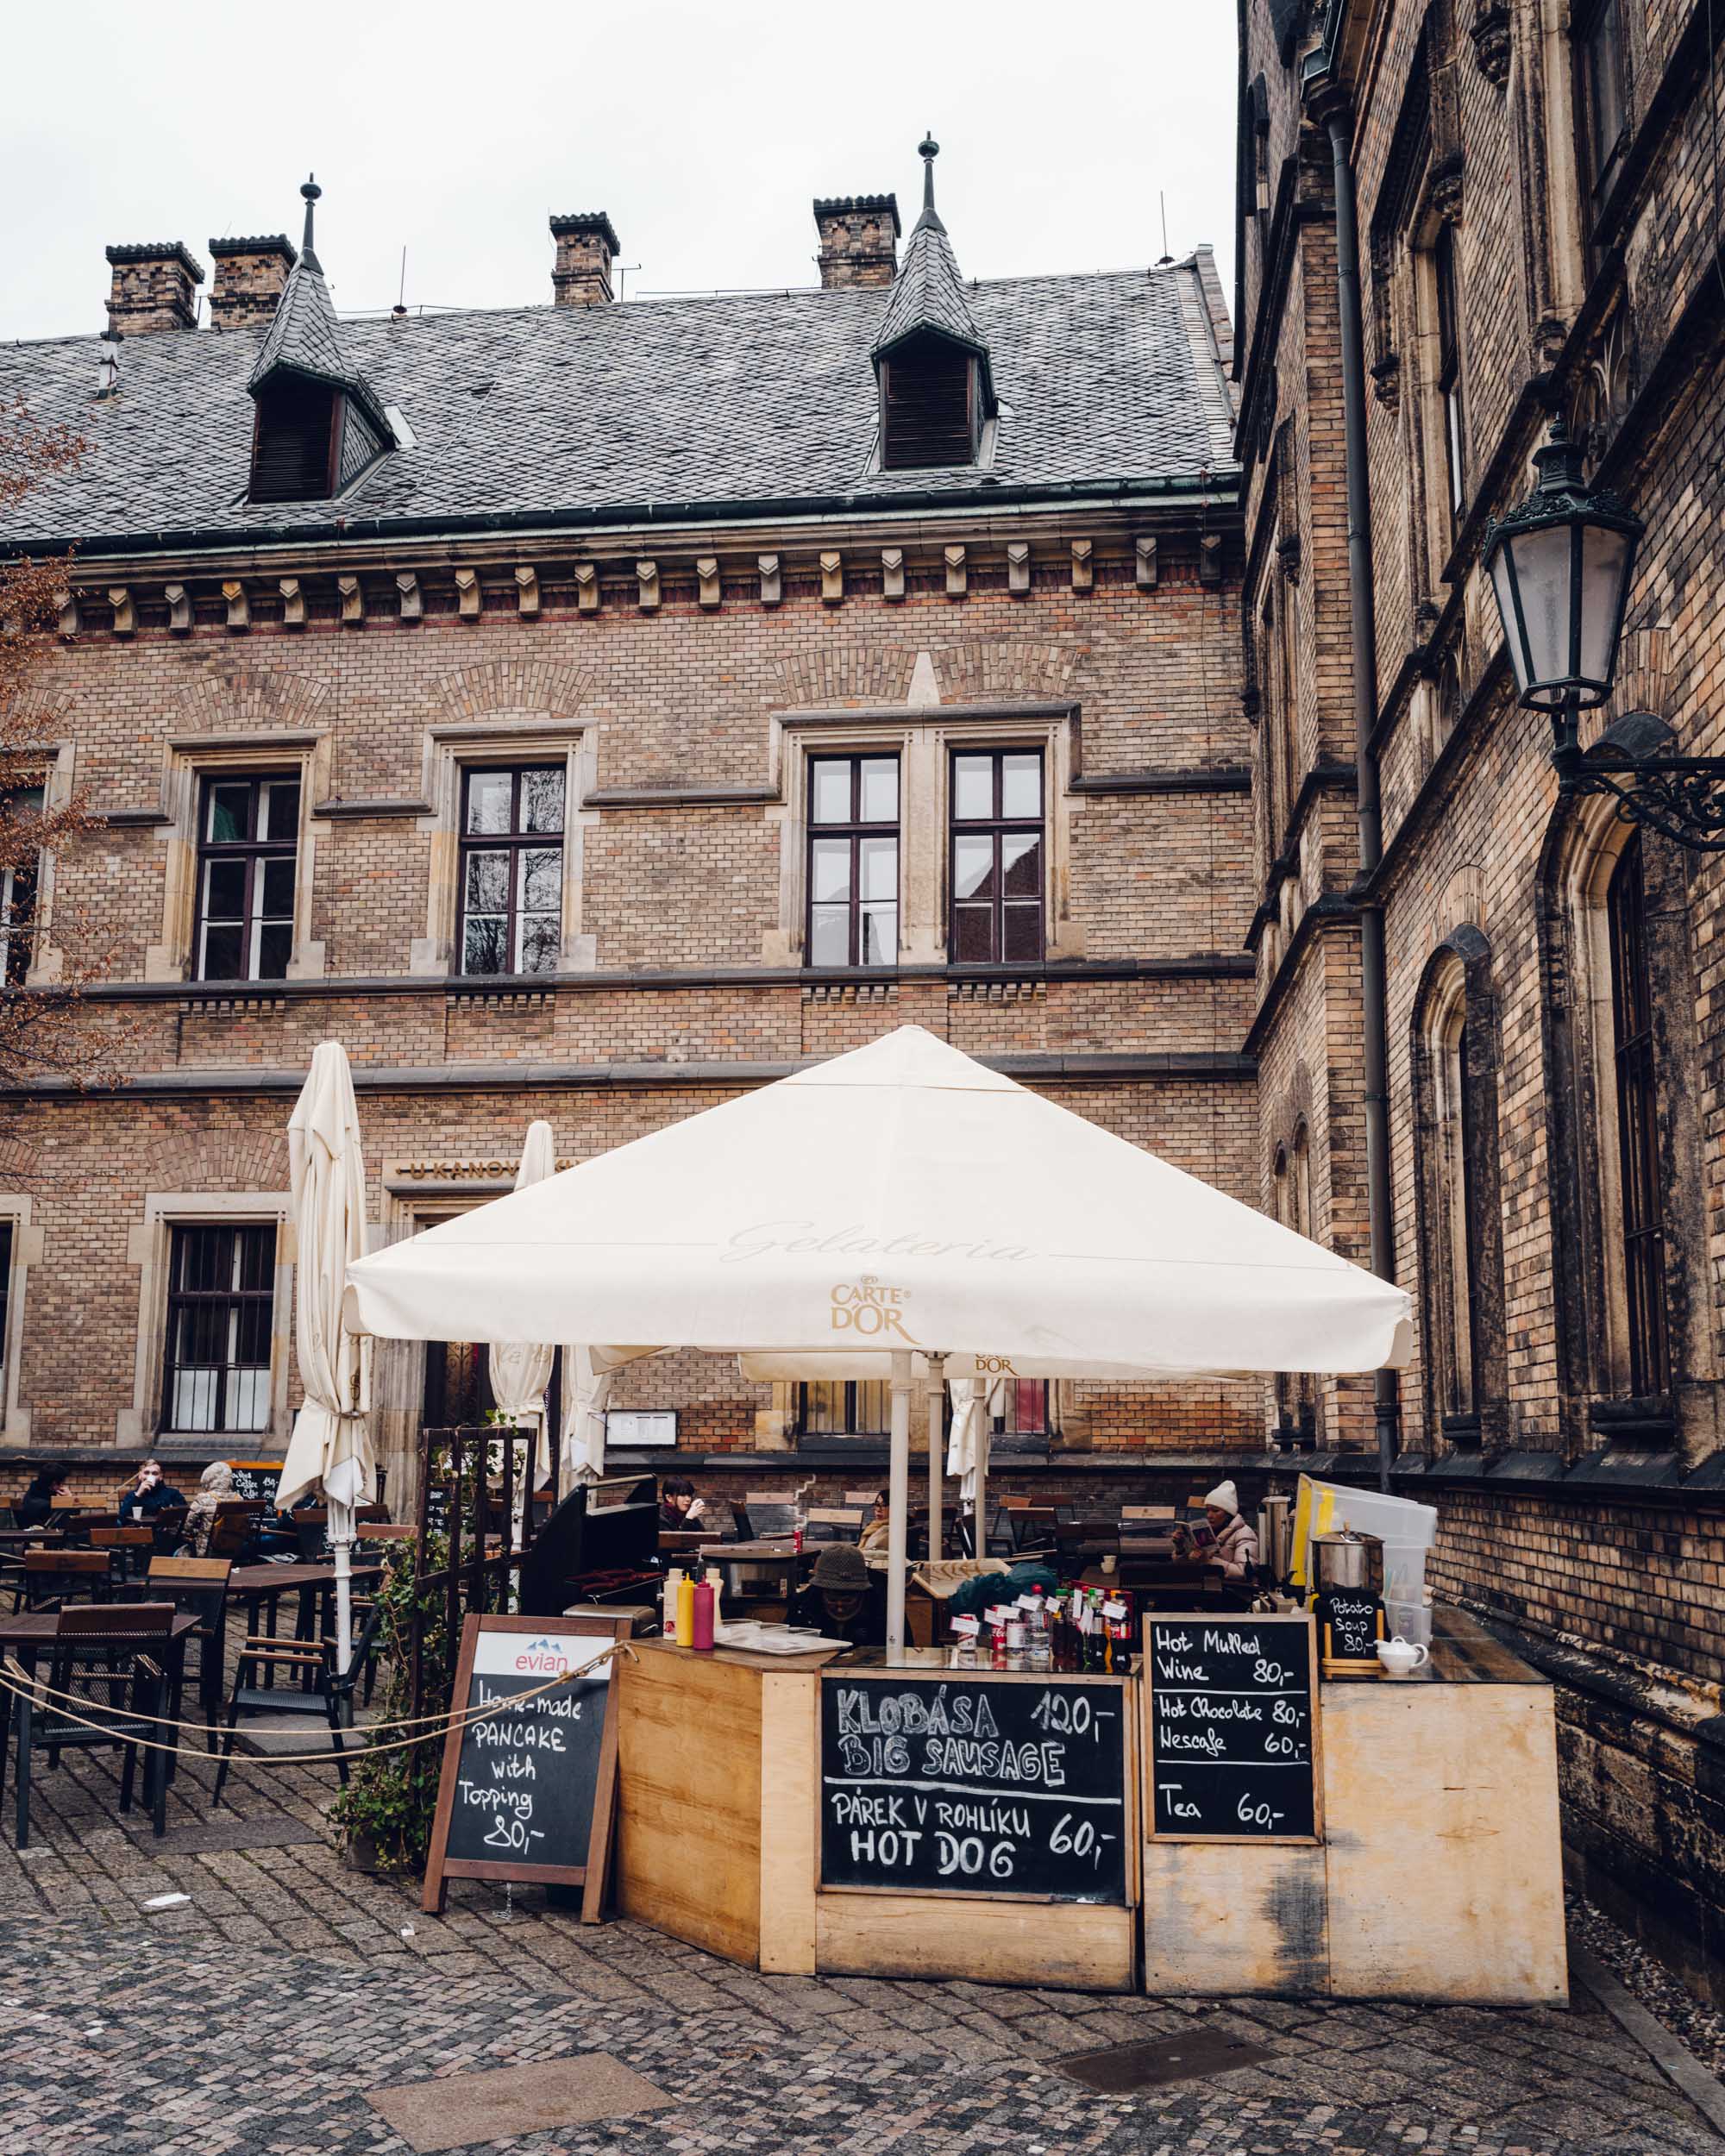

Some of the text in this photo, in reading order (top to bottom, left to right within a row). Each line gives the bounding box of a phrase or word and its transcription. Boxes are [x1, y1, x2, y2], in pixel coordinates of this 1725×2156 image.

[719, 1221, 1037, 1263] Gelateria
[831, 1283, 904, 1307] CARTE
[831, 1304, 924, 1344] D'OR
[1330, 1597, 1374, 1614] Potato
[1156, 1626, 1192, 1652] Hot
[1204, 1630, 1261, 1655] Mulled
[1344, 1634, 1374, 1653] 80,-
[515, 1653, 568, 1671] evian
[1157, 1657, 1294, 1686] Wine 80,-
[837, 1684, 1114, 1743] KLOBÁSA 120,-
[1159, 1695, 1306, 1728] Hot Chocolate 80,-
[472, 1722, 566, 1752] PANCAKE
[1160, 1725, 1306, 1758] Nescafe 60,-
[492, 1754, 536, 1780] with
[837, 1734, 1065, 1787] BIG SAUSAGE
[458, 1780, 532, 1820] Topping
[831, 1787, 1031, 1837] PÁREK V ROHLÍKU
[1158, 1783, 1284, 1829] Tea 60,-
[483, 1814, 544, 1854] 80,-
[1049, 1813, 1116, 1870] 60,-
[850, 1830, 1016, 1877] HOT DOG
